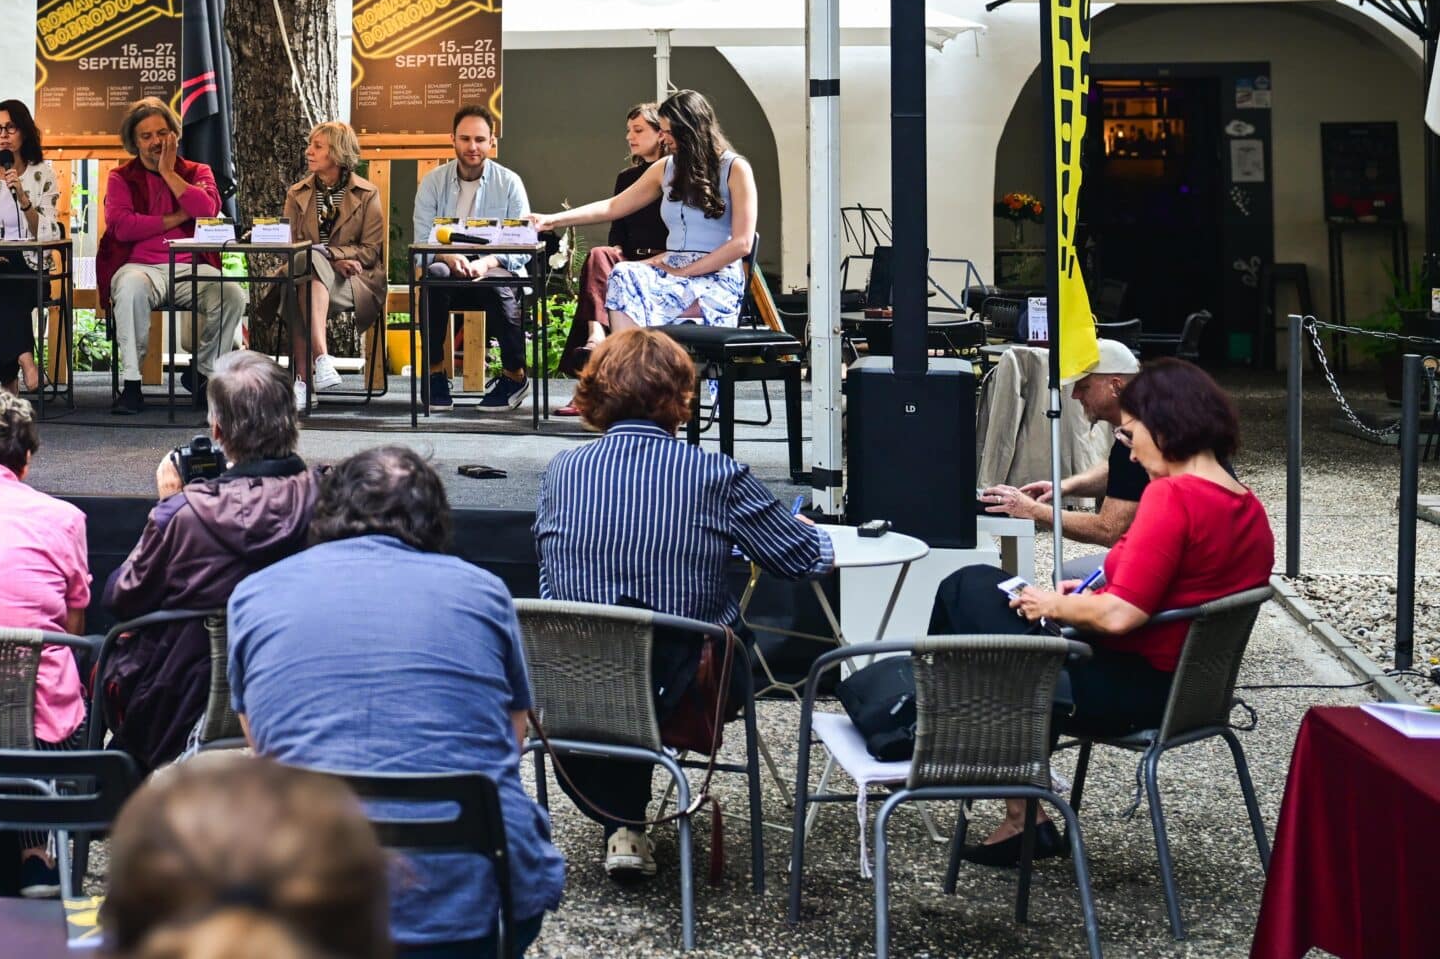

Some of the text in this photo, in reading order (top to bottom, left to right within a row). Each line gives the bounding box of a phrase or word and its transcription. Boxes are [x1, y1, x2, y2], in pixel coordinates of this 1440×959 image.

[78, 56, 177, 71] SEPTEMBER
[395, 52, 496, 68] SEPTEMBER
[139, 69, 177, 83] 2026
[458, 66, 497, 80] 2026
[905, 404, 916, 413] LD
